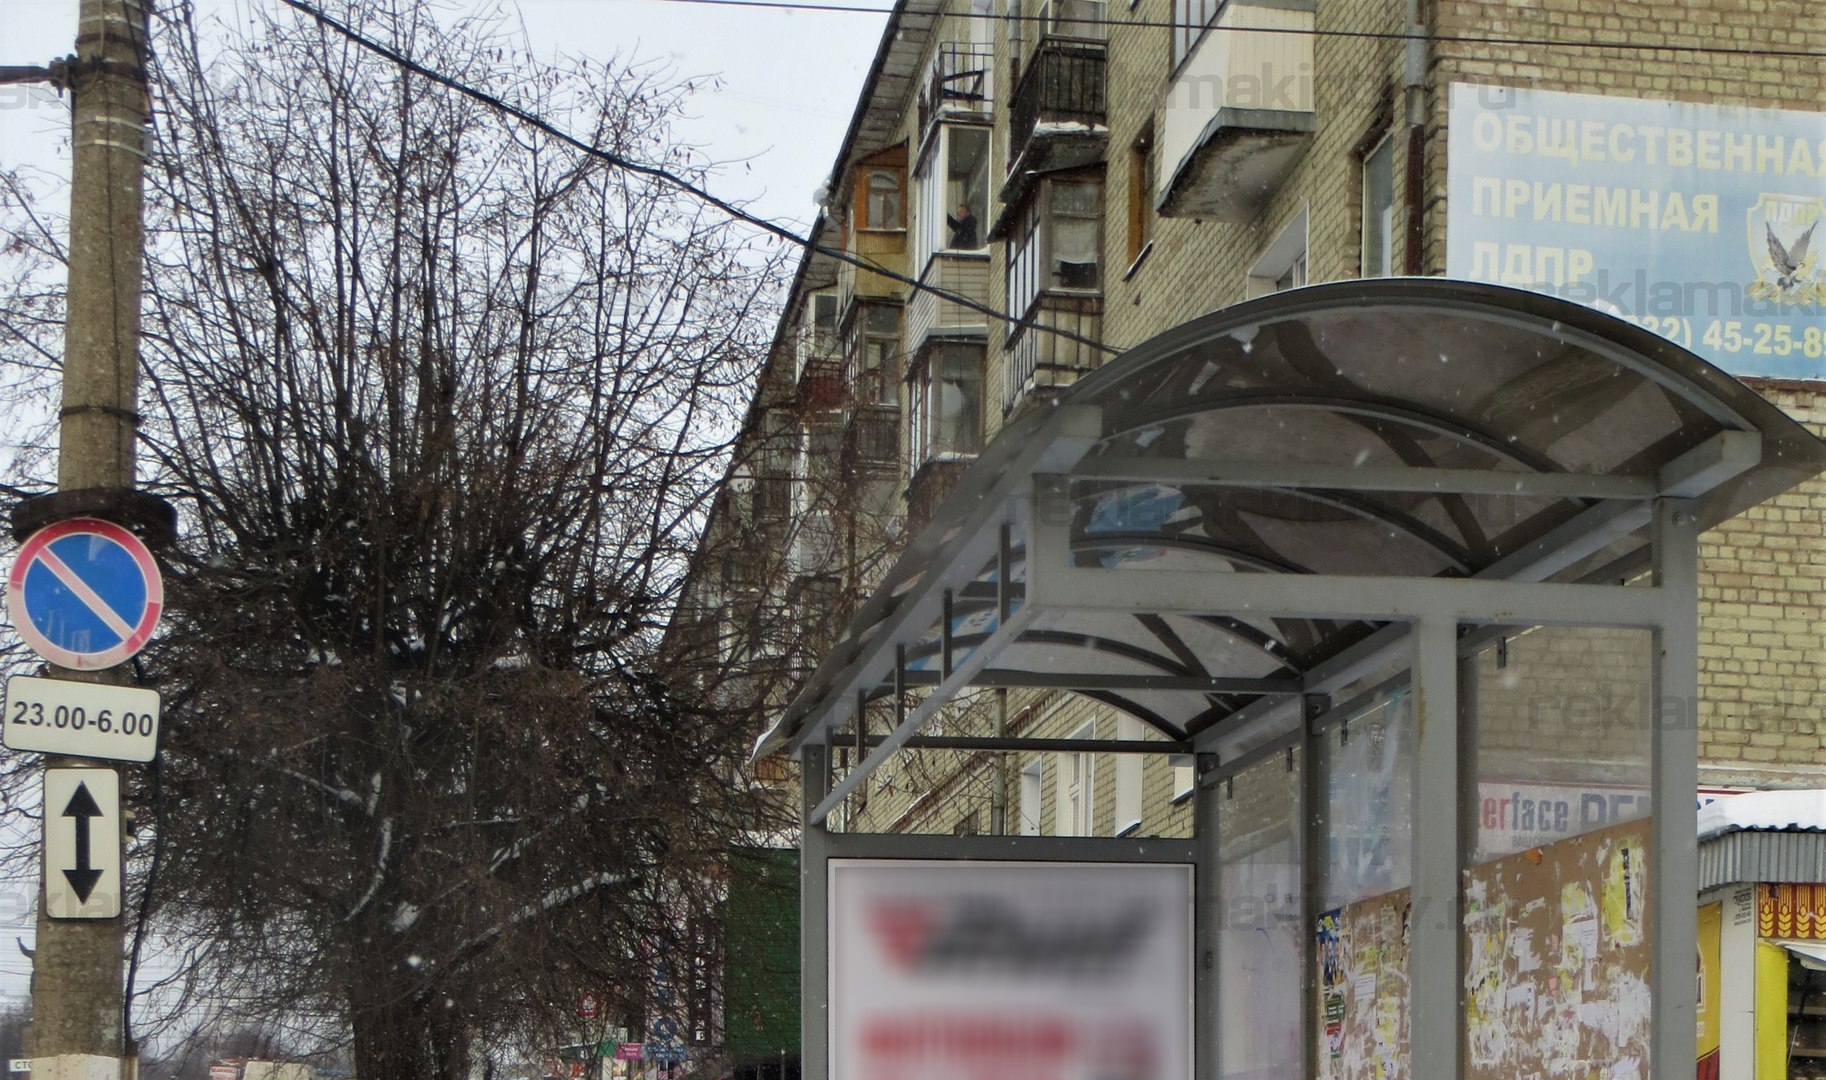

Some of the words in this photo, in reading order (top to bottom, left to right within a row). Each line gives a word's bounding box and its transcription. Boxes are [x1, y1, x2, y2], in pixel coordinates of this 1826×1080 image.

[1471, 176, 1720, 235] ПРИЕМНАЯ
[1469, 242, 1593, 288] ЛДПР
[12, 700, 154, 738] 23.00-6.00
[1479, 791, 1569, 833] erface
